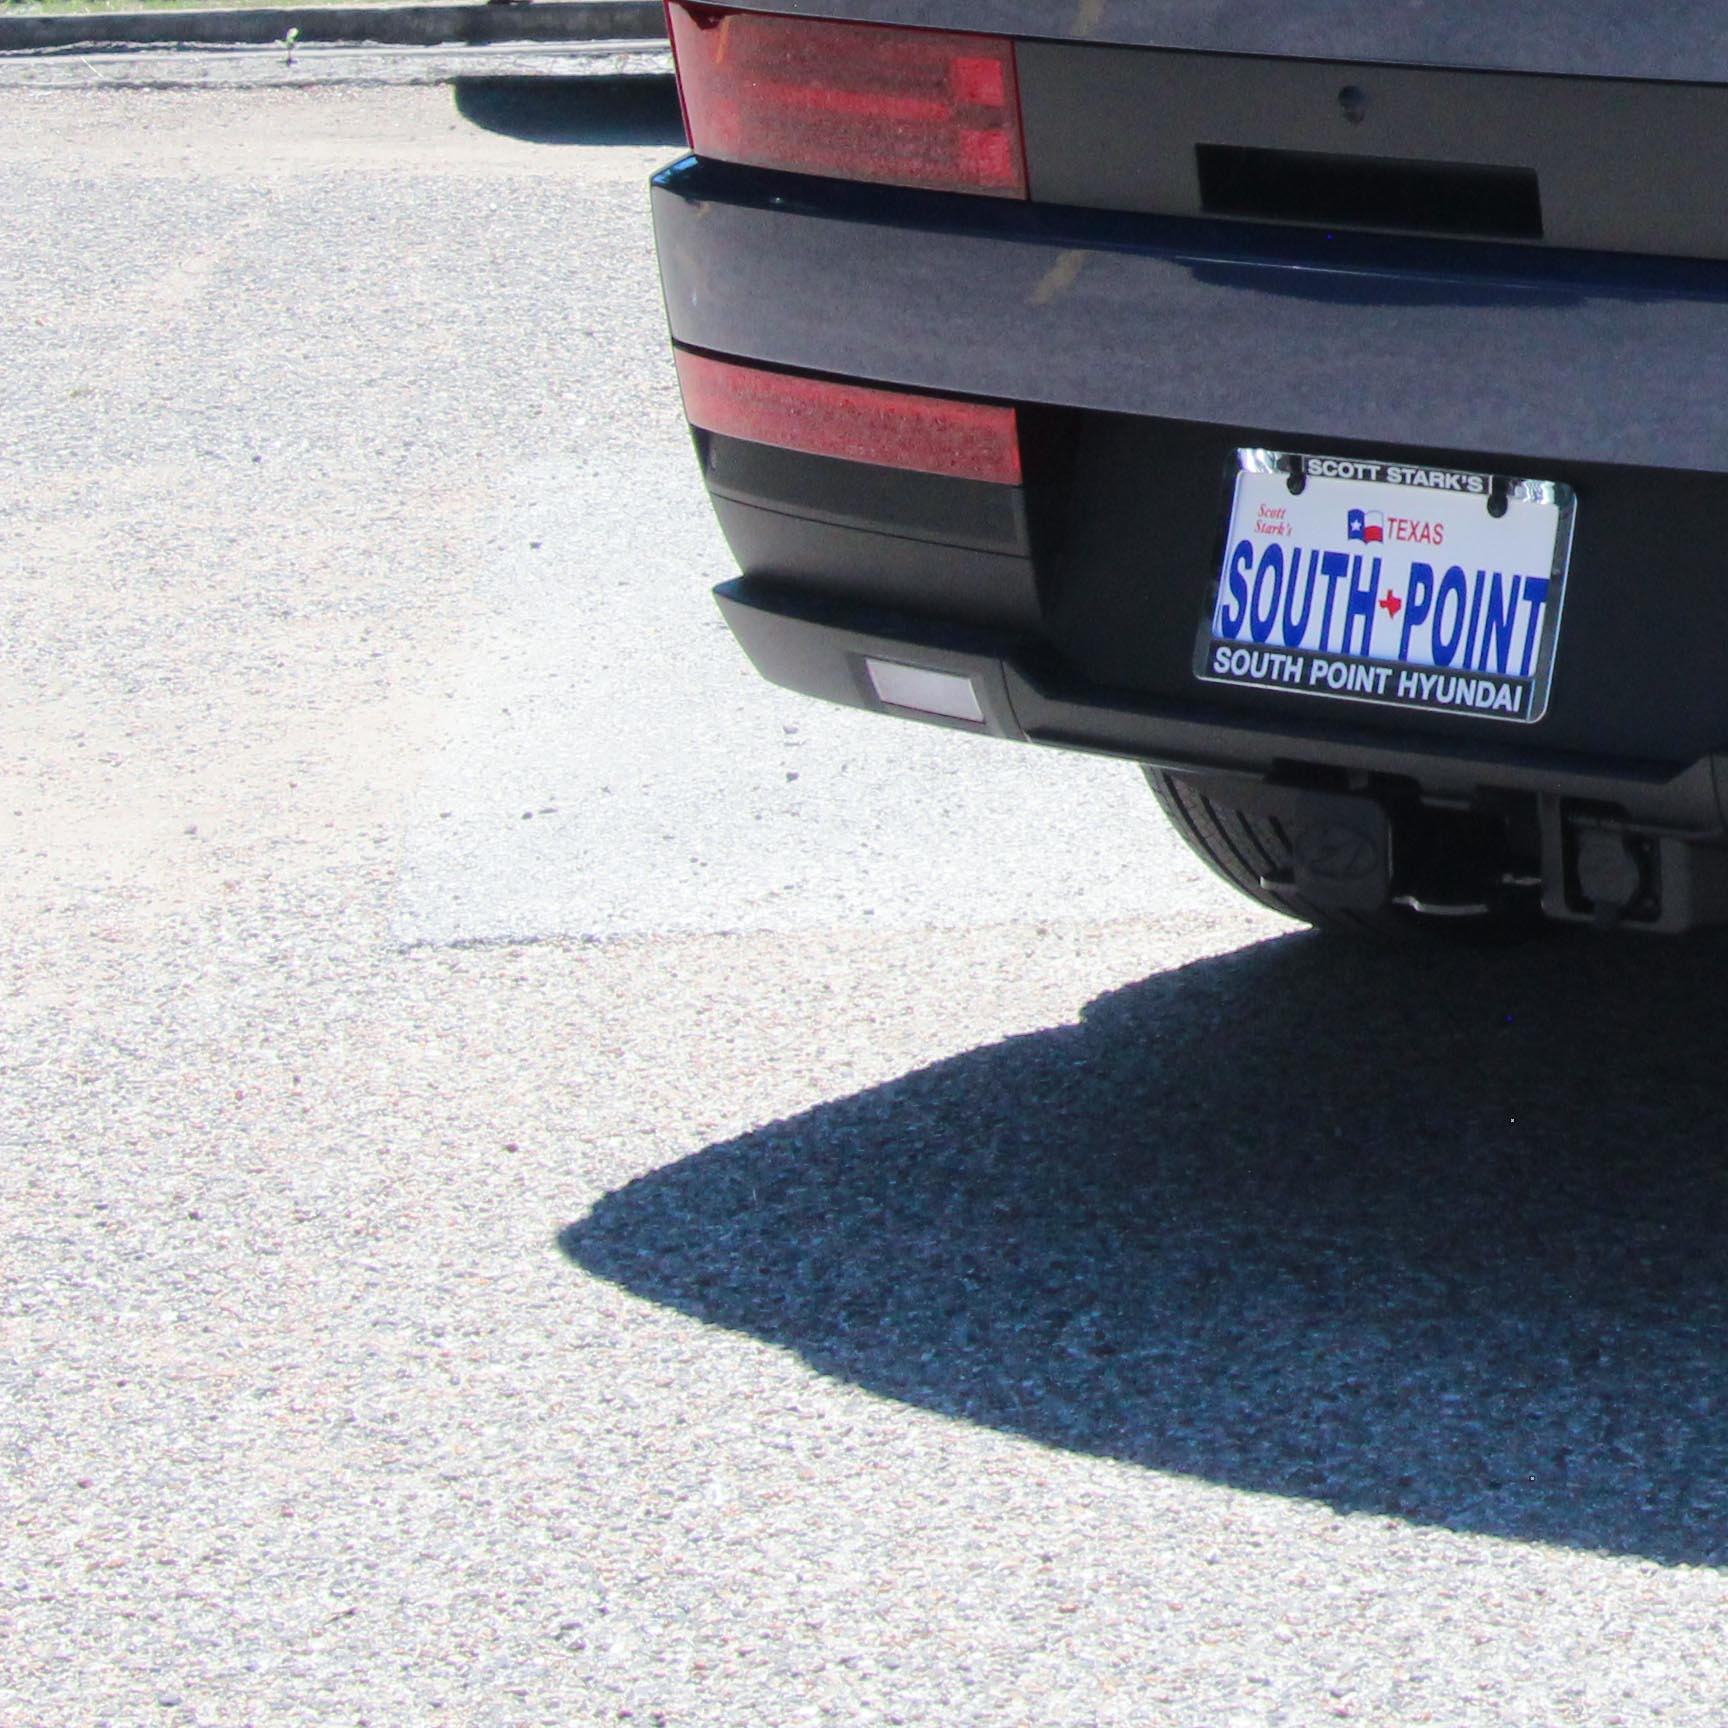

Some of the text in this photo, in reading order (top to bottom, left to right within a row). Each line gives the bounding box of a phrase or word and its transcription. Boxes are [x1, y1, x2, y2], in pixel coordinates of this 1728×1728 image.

[1308, 459, 1484, 494] SCOTT STARK'S
[1257, 503, 1287, 519] Scott
[1253, 519, 1293, 538] Stark's
[1387, 517, 1445, 546] TEXAS
[1220, 539, 1551, 678] SOUTH POINT
[1213, 646, 1523, 713] SOUTH POINT HYUNDAI
